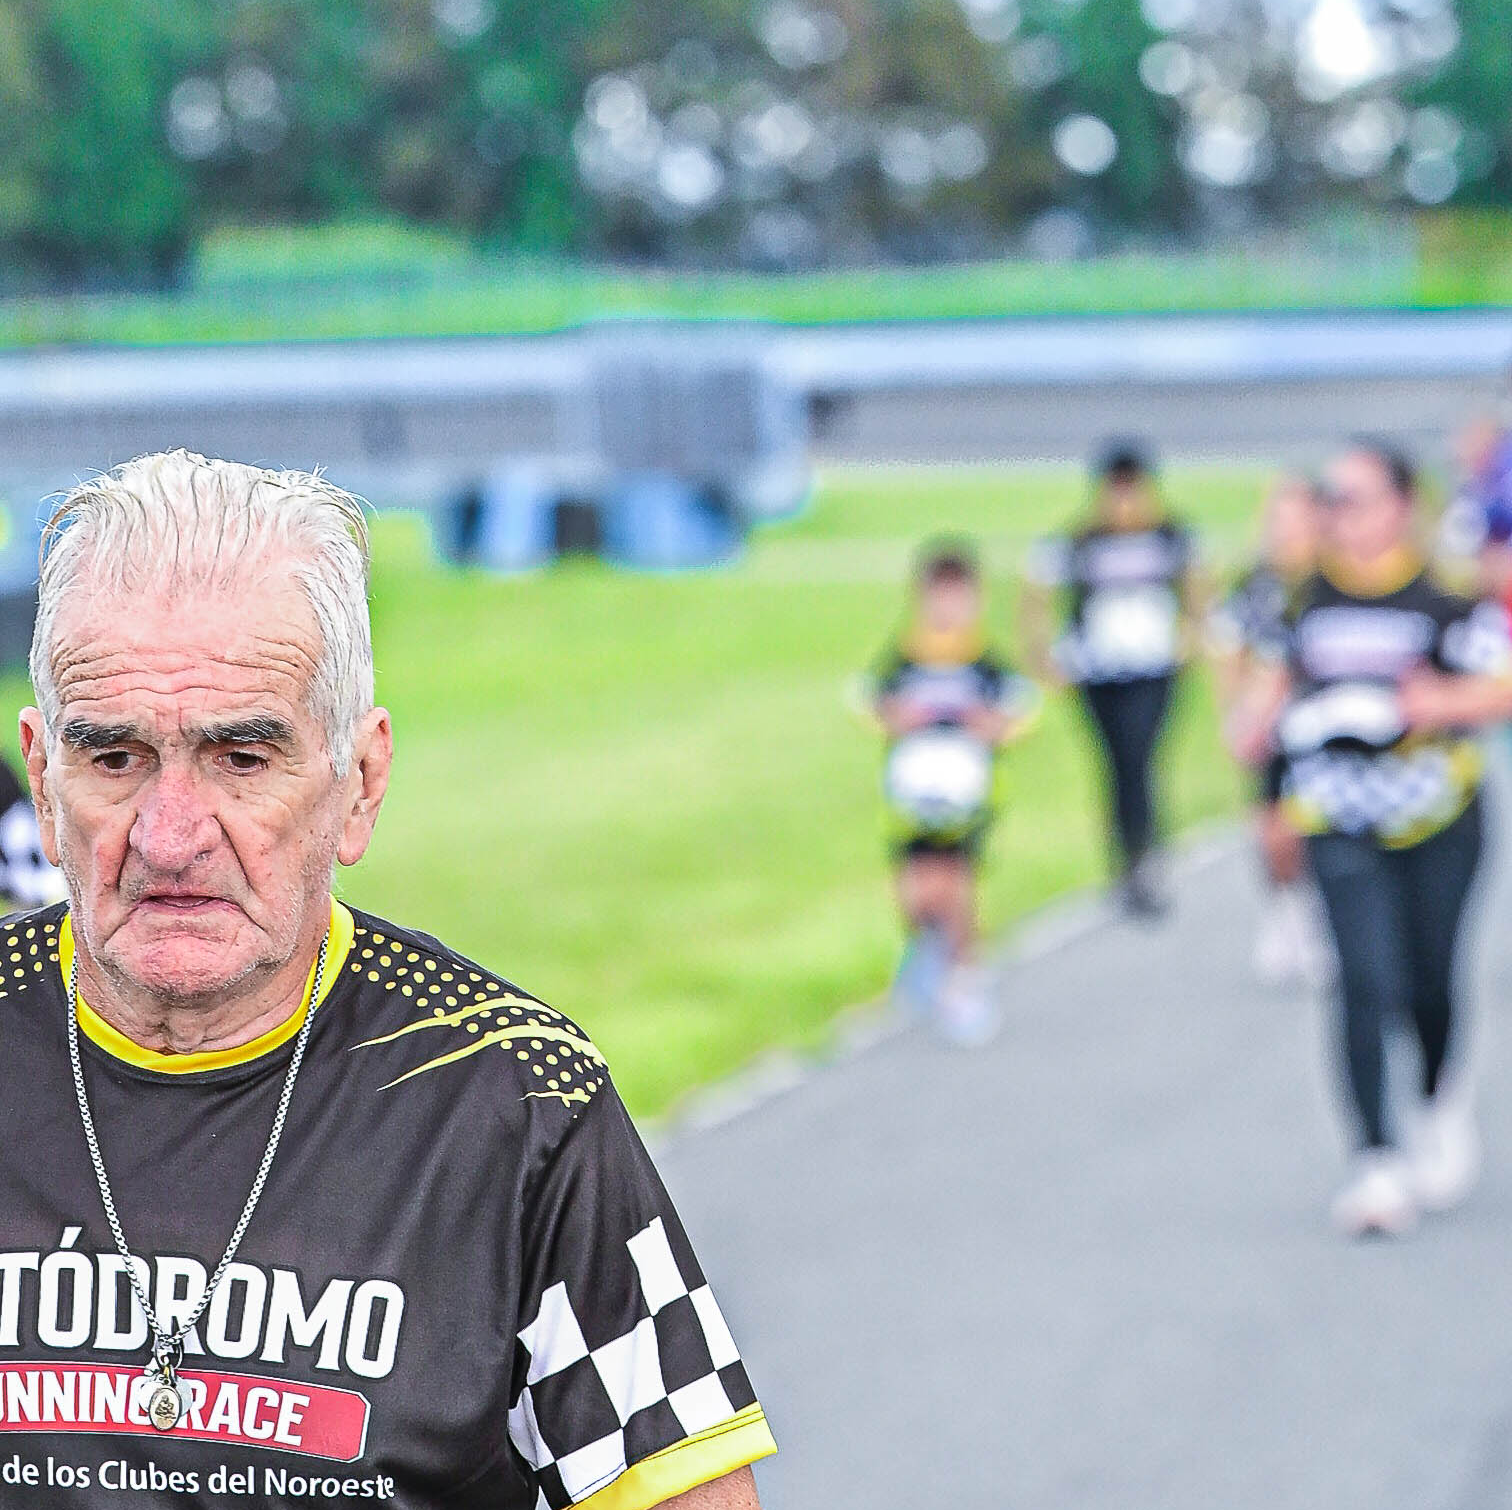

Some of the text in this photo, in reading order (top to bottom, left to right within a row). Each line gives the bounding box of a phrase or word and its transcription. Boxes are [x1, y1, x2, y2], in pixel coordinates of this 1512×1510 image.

[2, 1454, 39, 1485] de
[47, 1456, 91, 1489] los
[98, 1460, 200, 1493] Clubes
[208, 1465, 255, 1495] del
[265, 1467, 395, 1499] Noroeste
